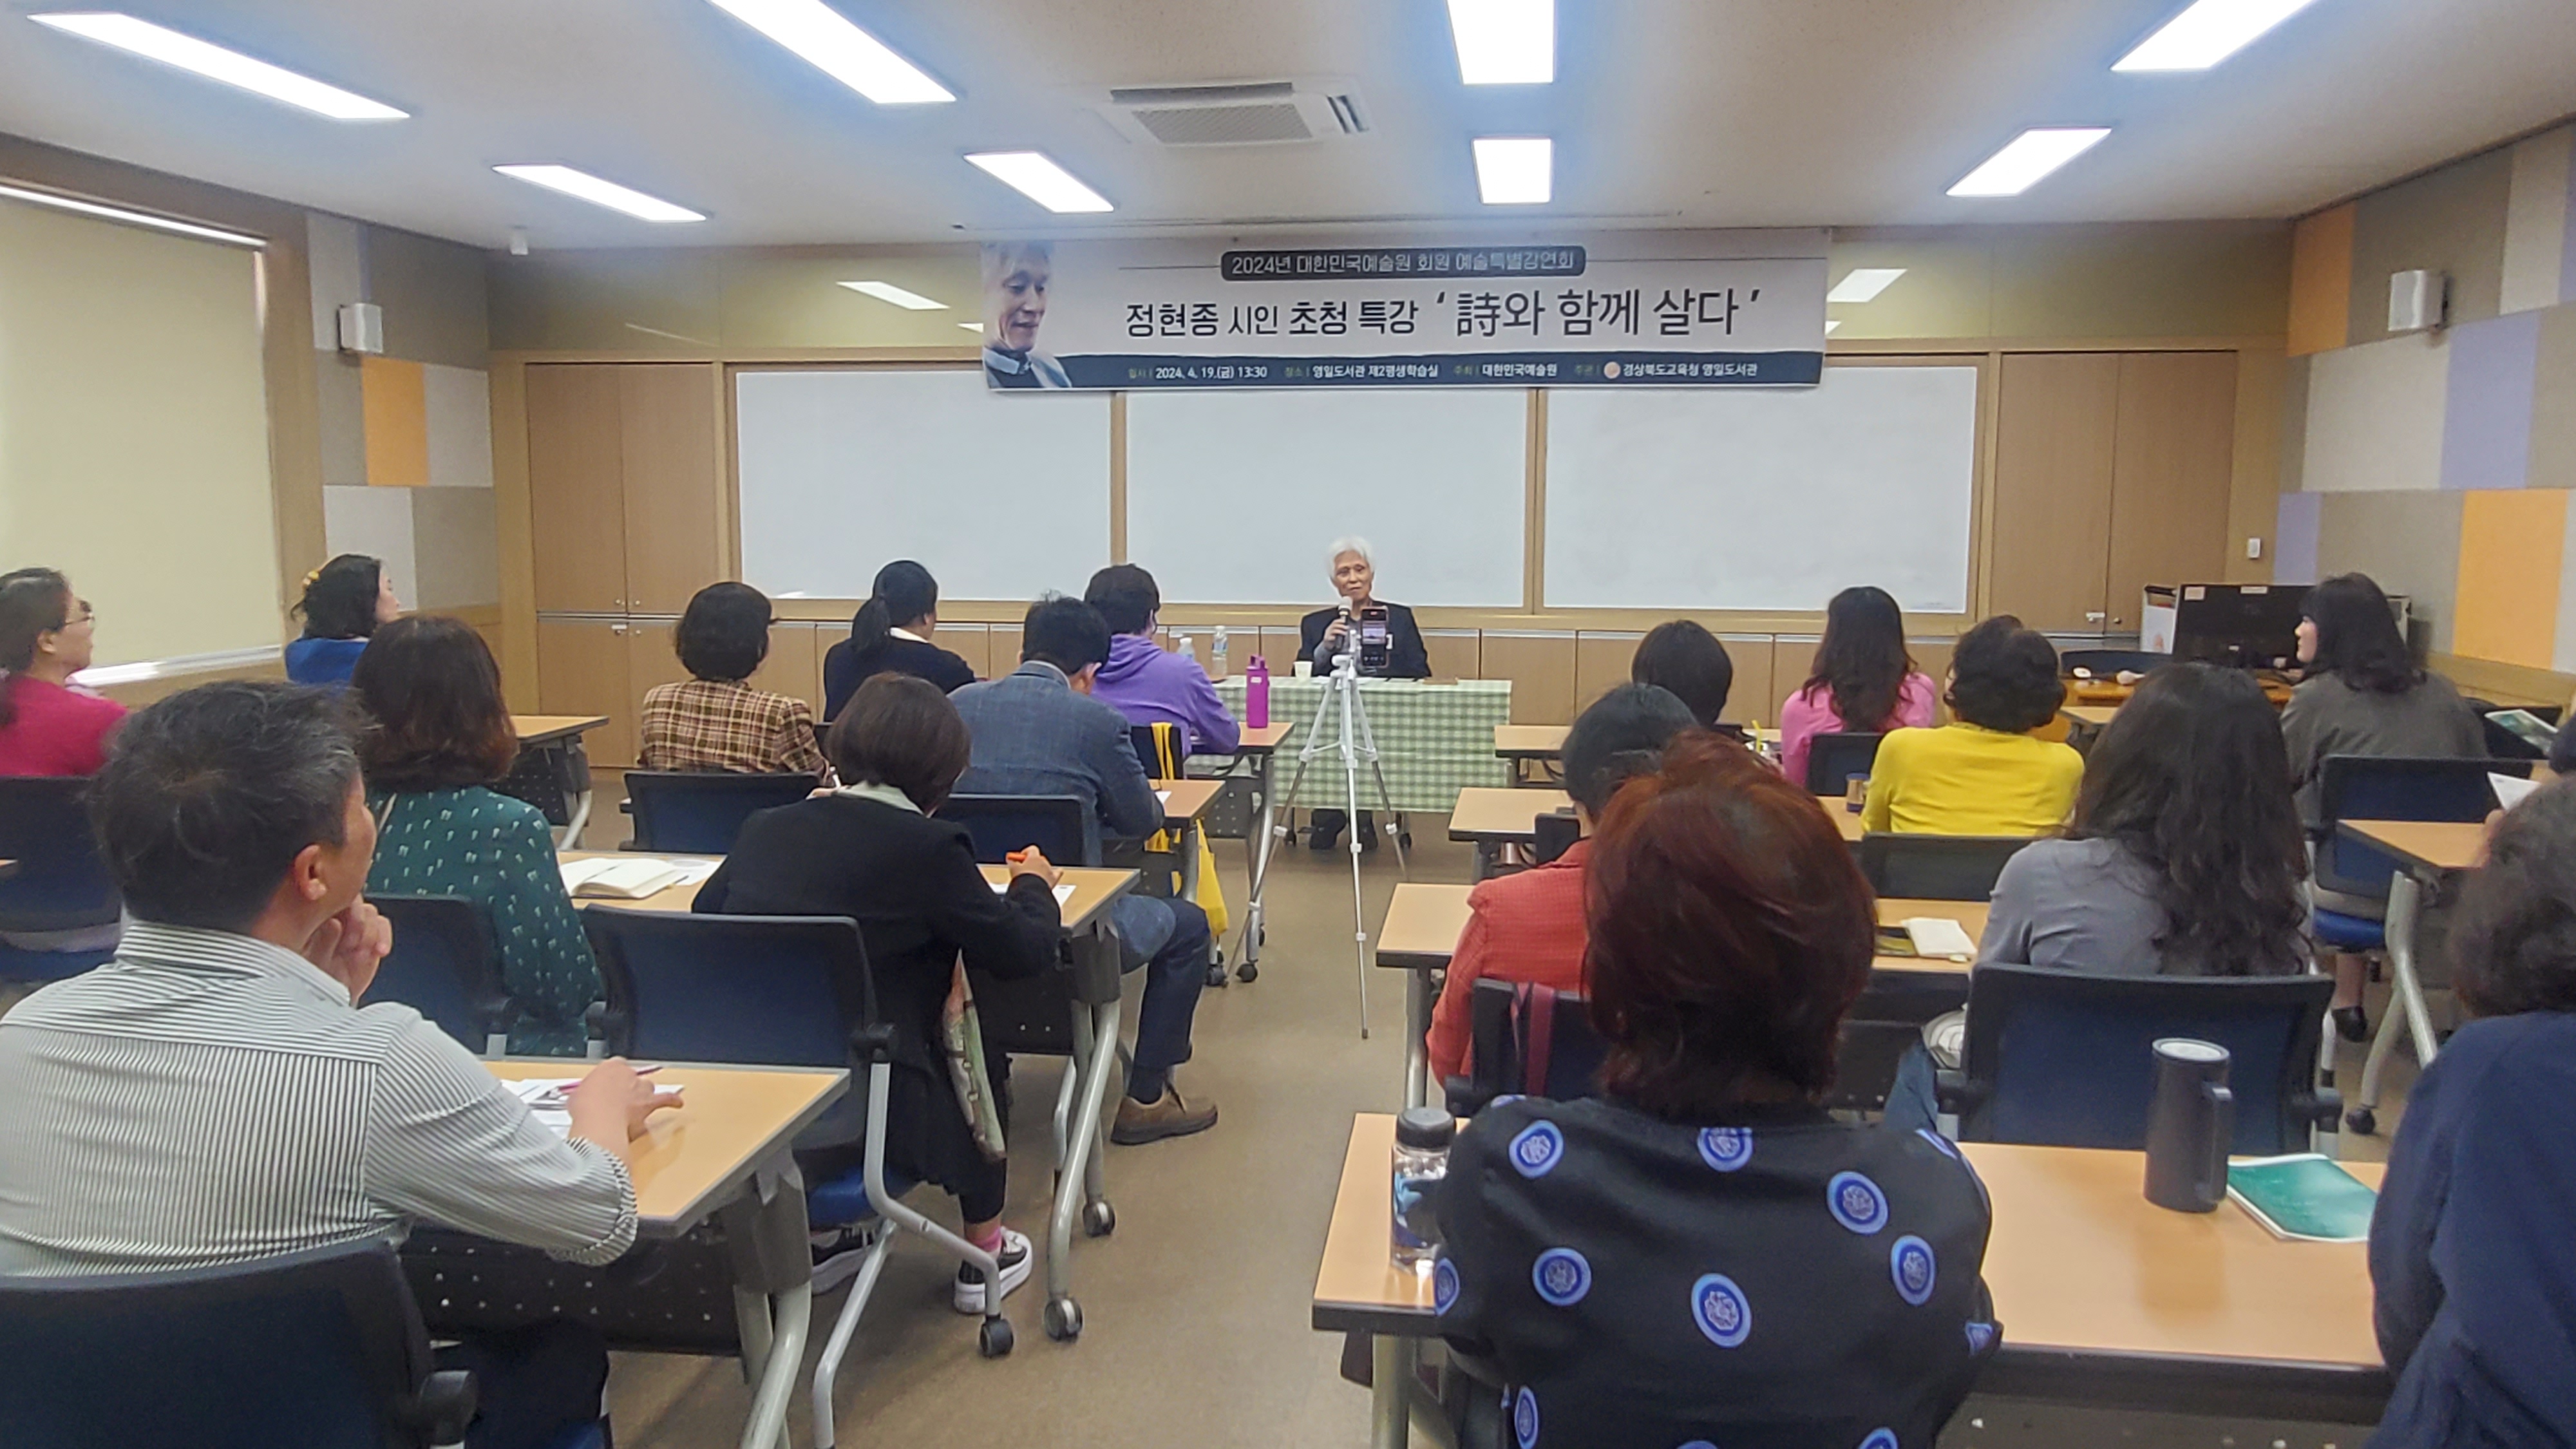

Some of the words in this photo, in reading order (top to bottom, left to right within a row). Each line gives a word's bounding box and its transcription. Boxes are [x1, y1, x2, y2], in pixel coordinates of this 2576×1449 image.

[1231, 256, 1291, 274] 2024년
[1296, 254, 1410, 273] 대한민국예술원
[1417, 253, 1449, 271] 회원
[1126, 302, 1219, 337] 정현종
[1227, 305, 1278, 336] 시인
[1289, 301, 1349, 336] 초청
[1358, 299, 1419, 336] 특강
[1557, 289, 1640, 336] 함께
[1237, 366, 1268, 378] 13:30
[1312, 365, 1365, 378] 영일도서관
[1368, 365, 1439, 377] 제2평생학습실
[1482, 363, 1558, 377] 대한민국예술원
[1623, 363, 1700, 377] 경상북도교육청
[1702, 363, 1758, 377] 영일도서관
